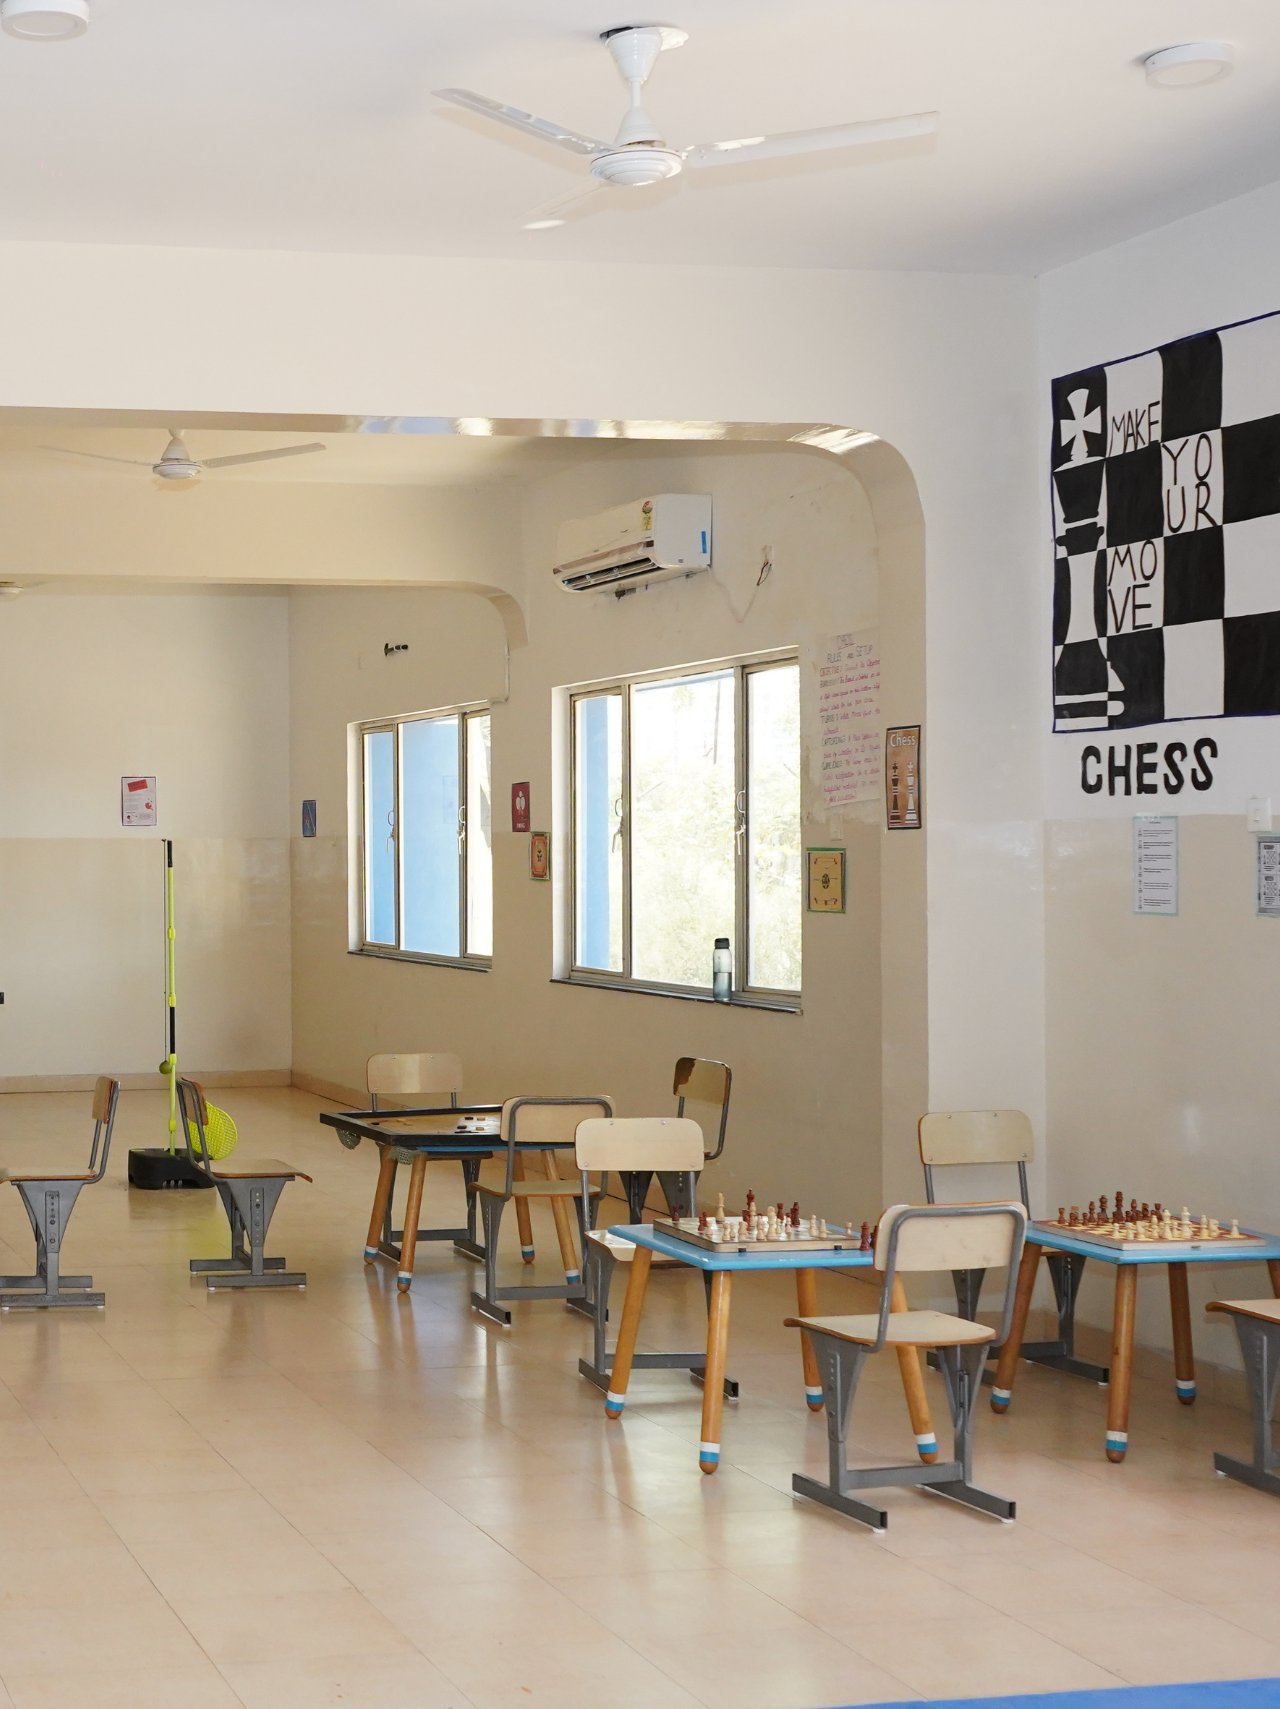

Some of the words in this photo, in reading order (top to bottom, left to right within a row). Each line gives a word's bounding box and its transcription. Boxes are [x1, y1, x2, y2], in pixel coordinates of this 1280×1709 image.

[1108, 400, 1161, 458] MAKE
[890, 733, 916, 747] Chess
[1081, 738, 1218, 796] CHESS
